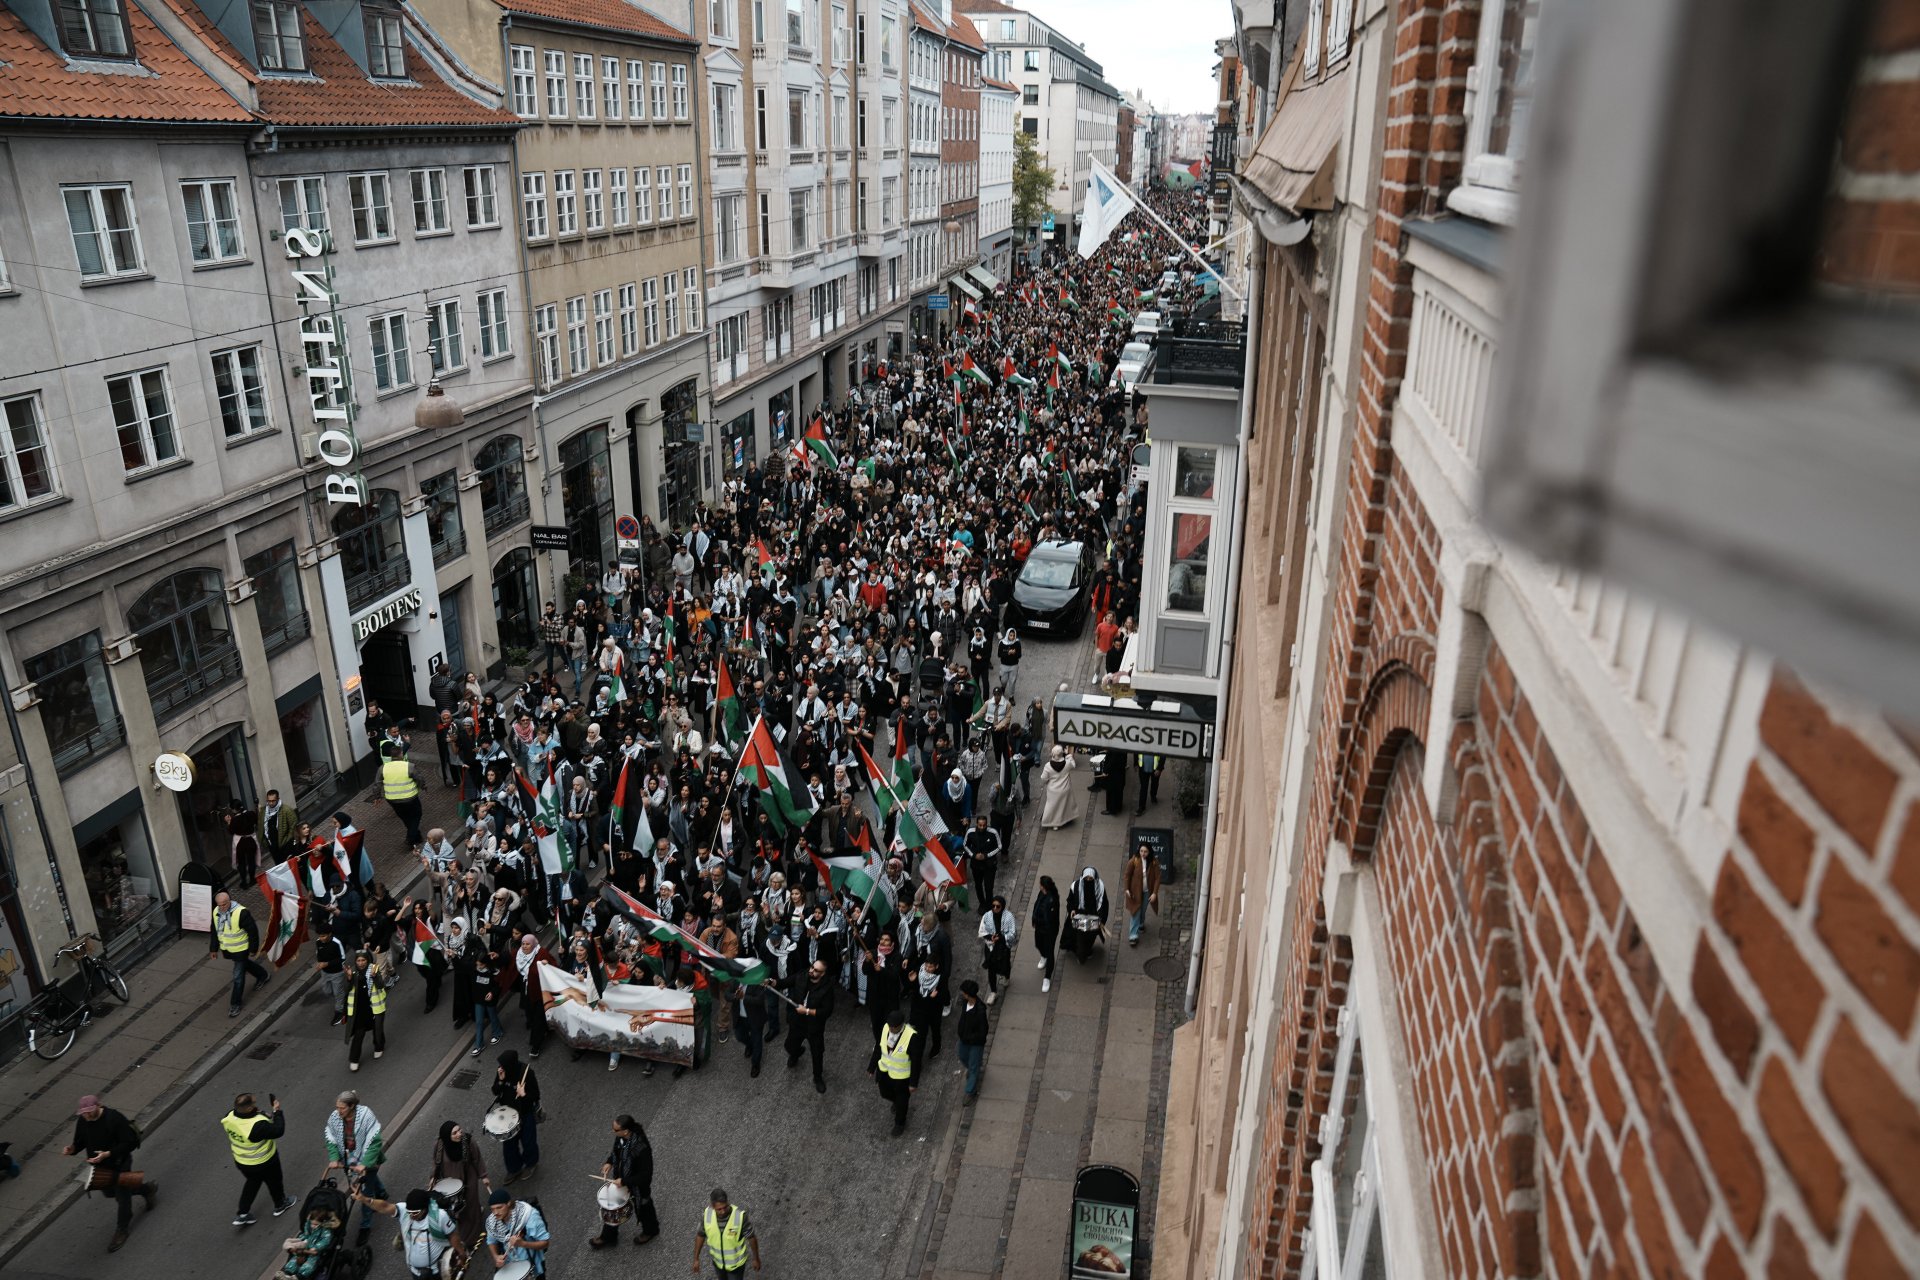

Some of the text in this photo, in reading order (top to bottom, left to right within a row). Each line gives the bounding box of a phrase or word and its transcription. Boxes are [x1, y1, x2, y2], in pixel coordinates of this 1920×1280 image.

[357, 588, 423, 641] BOLTENS
[431, 656, 440, 674] P
[160, 761, 188, 782] Sky
[1080, 1206, 1129, 1228] BUKA
[1084, 1225, 1123, 1236] PISTACHIO
